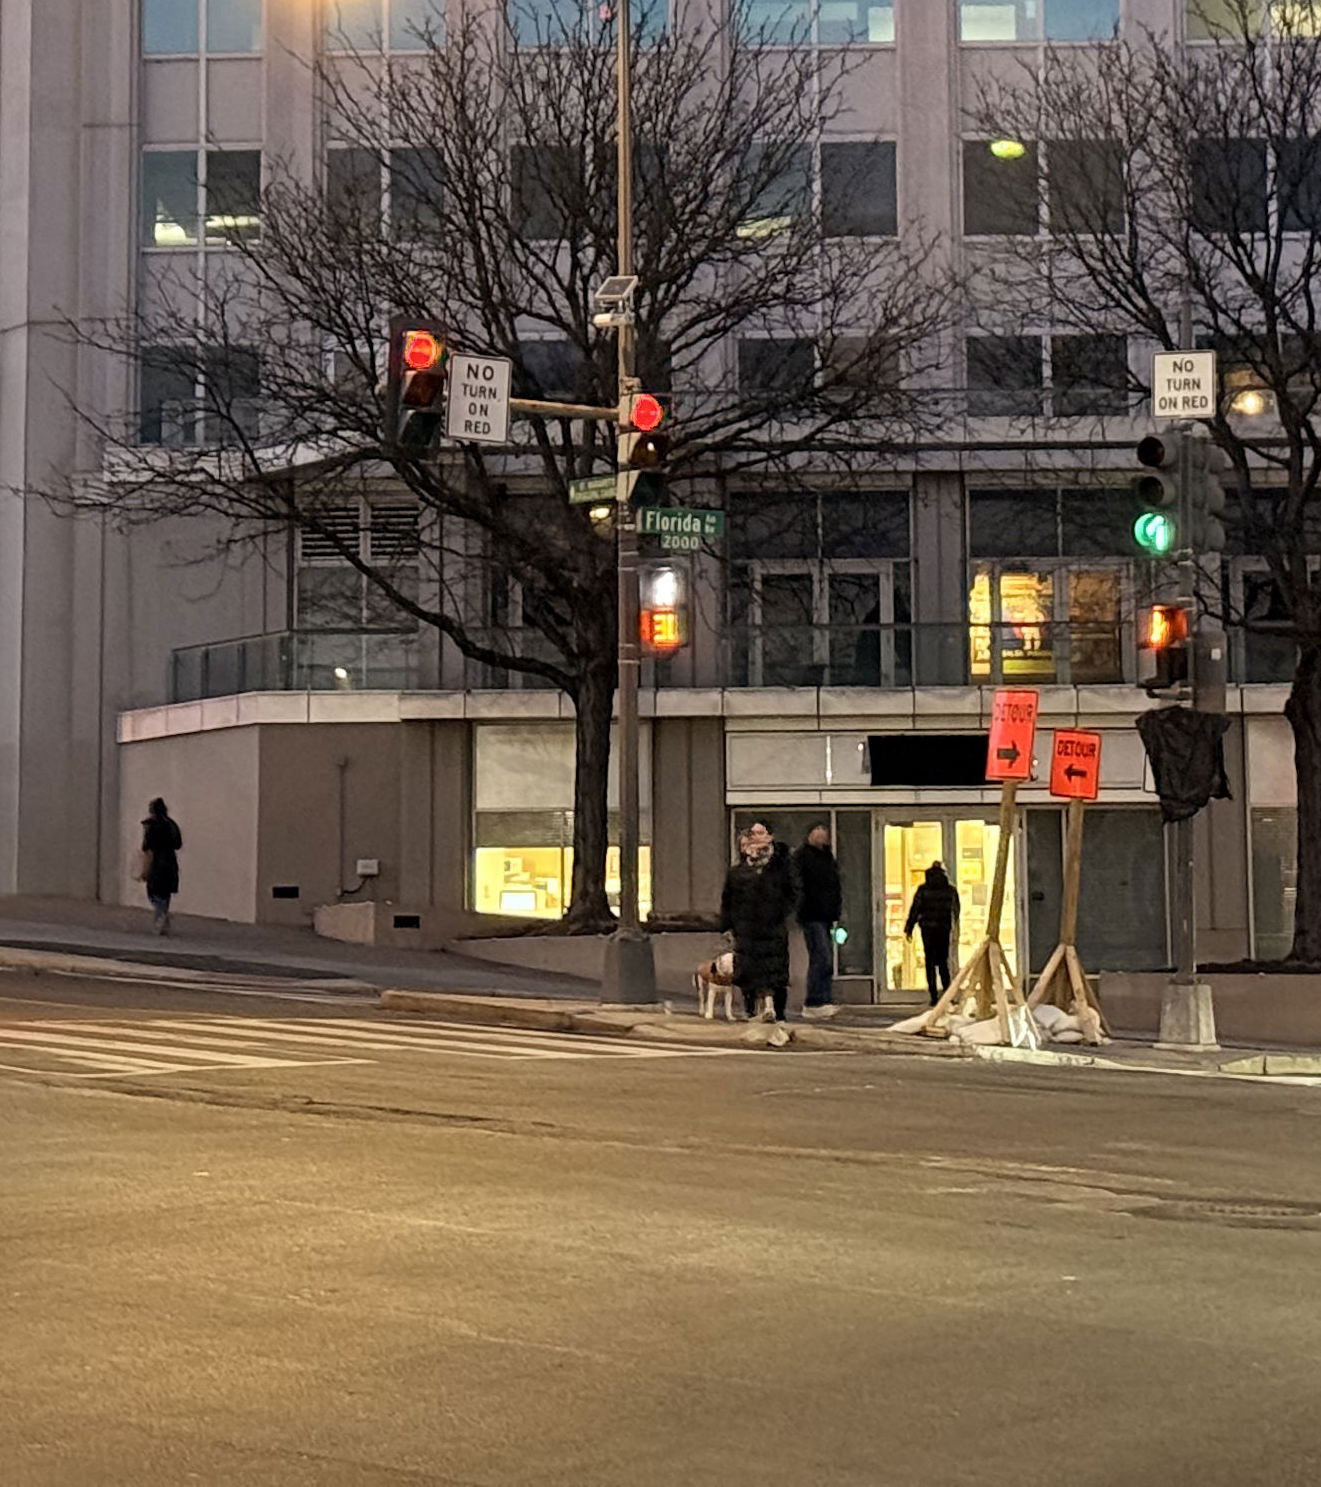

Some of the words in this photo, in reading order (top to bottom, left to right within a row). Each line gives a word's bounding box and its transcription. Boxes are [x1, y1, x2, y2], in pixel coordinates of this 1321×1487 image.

[466, 362, 495, 381] NO
[1172, 358, 1195, 373] NO
[461, 382, 497, 400] TURN
[1166, 377, 1201, 392] TURN
[468, 401, 489, 417] ON
[1158, 396, 1178, 411] ON
[1181, 395, 1209, 410] RED
[464, 419, 491, 435] RED
[645, 510, 701, 533] Florida
[662, 535, 700, 550] 2000
[1057, 739, 1096, 758] DETOUR
